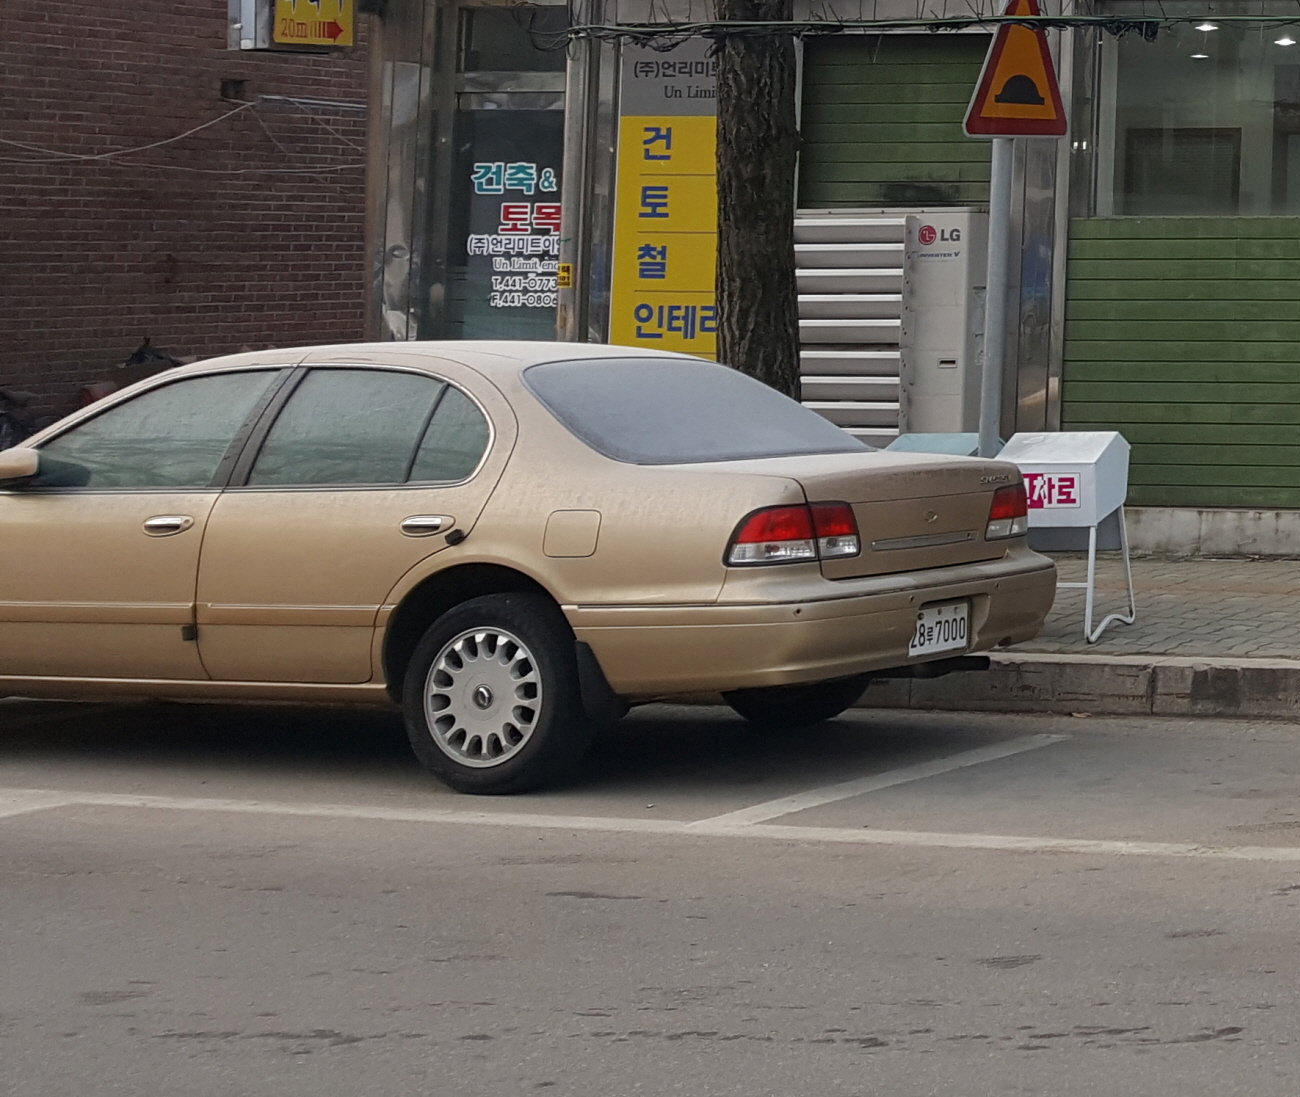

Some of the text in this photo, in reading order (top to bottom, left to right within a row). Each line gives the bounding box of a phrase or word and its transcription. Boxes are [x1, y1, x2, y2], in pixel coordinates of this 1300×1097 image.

[280, 18, 308, 39] 20m
[664, 85, 717, 99] Un Limi
[471, 162, 537, 195] 건축
[498, 203, 562, 235] 토목
[940, 228, 961, 242] LG
